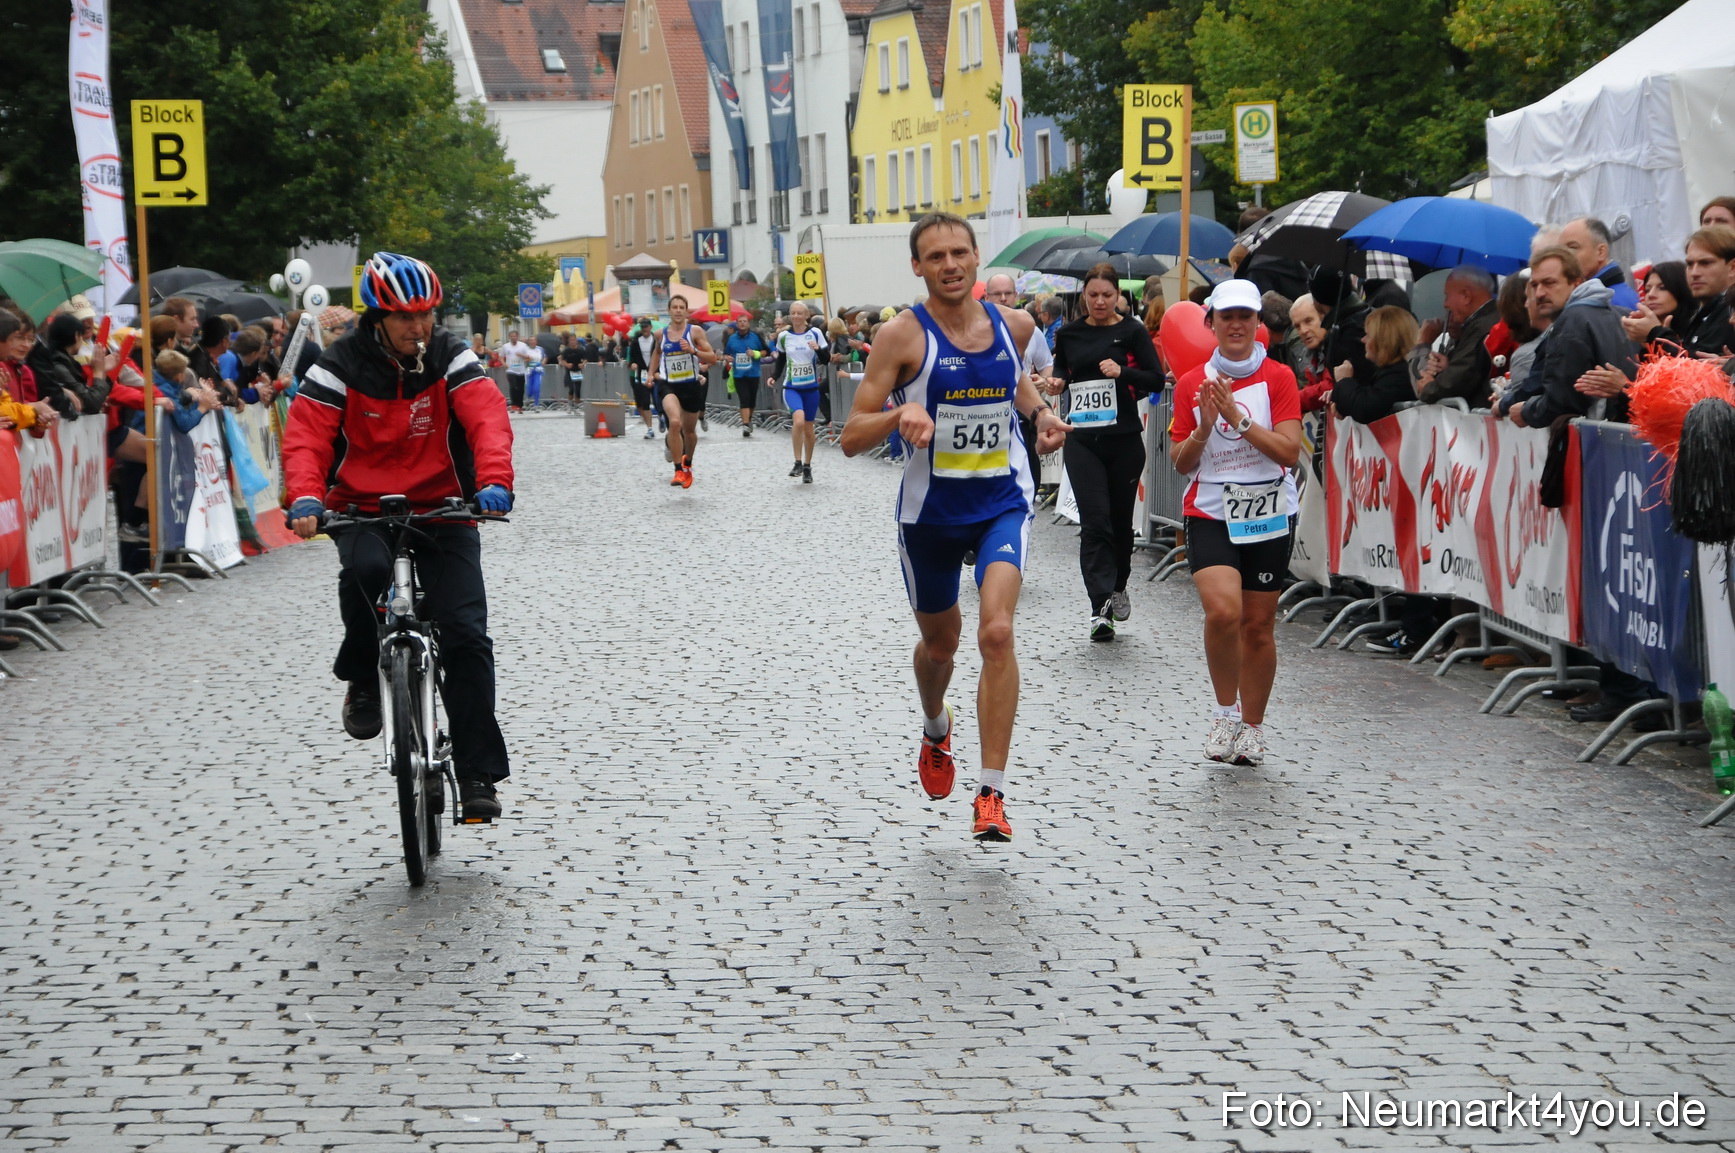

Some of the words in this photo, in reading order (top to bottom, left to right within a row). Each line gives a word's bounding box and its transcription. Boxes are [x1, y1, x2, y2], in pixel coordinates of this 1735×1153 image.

[1132, 89, 1184, 107] Block
[140, 105, 195, 123] Block
[891, 118, 912, 141] HOTEL
[1248, 114, 1263, 132] H
[1141, 116, 1174, 165] B
[151, 132, 187, 181] B
[796, 255, 820, 265] Block
[802, 267, 817, 289] C
[713, 290, 725, 307] D
[522, 307, 541, 315] TAXI
[671, 360, 687, 372] 487
[939, 357, 966, 365] HEITEC
[793, 365, 813, 377] 2795
[945, 389, 966, 400] LAC
[967, 387, 1007, 398] QUELLE
[1075, 391, 1112, 411] 2496
[938, 412, 965, 420] PARTL
[967, 411, 1002, 420] Neumarkt
[1085, 413, 1099, 421] Anja
[952, 422, 1000, 450] 543
[1235, 446, 1247, 455] MIT
[1227, 490, 1279, 519] 2727
[1244, 523, 1268, 534] Petra
